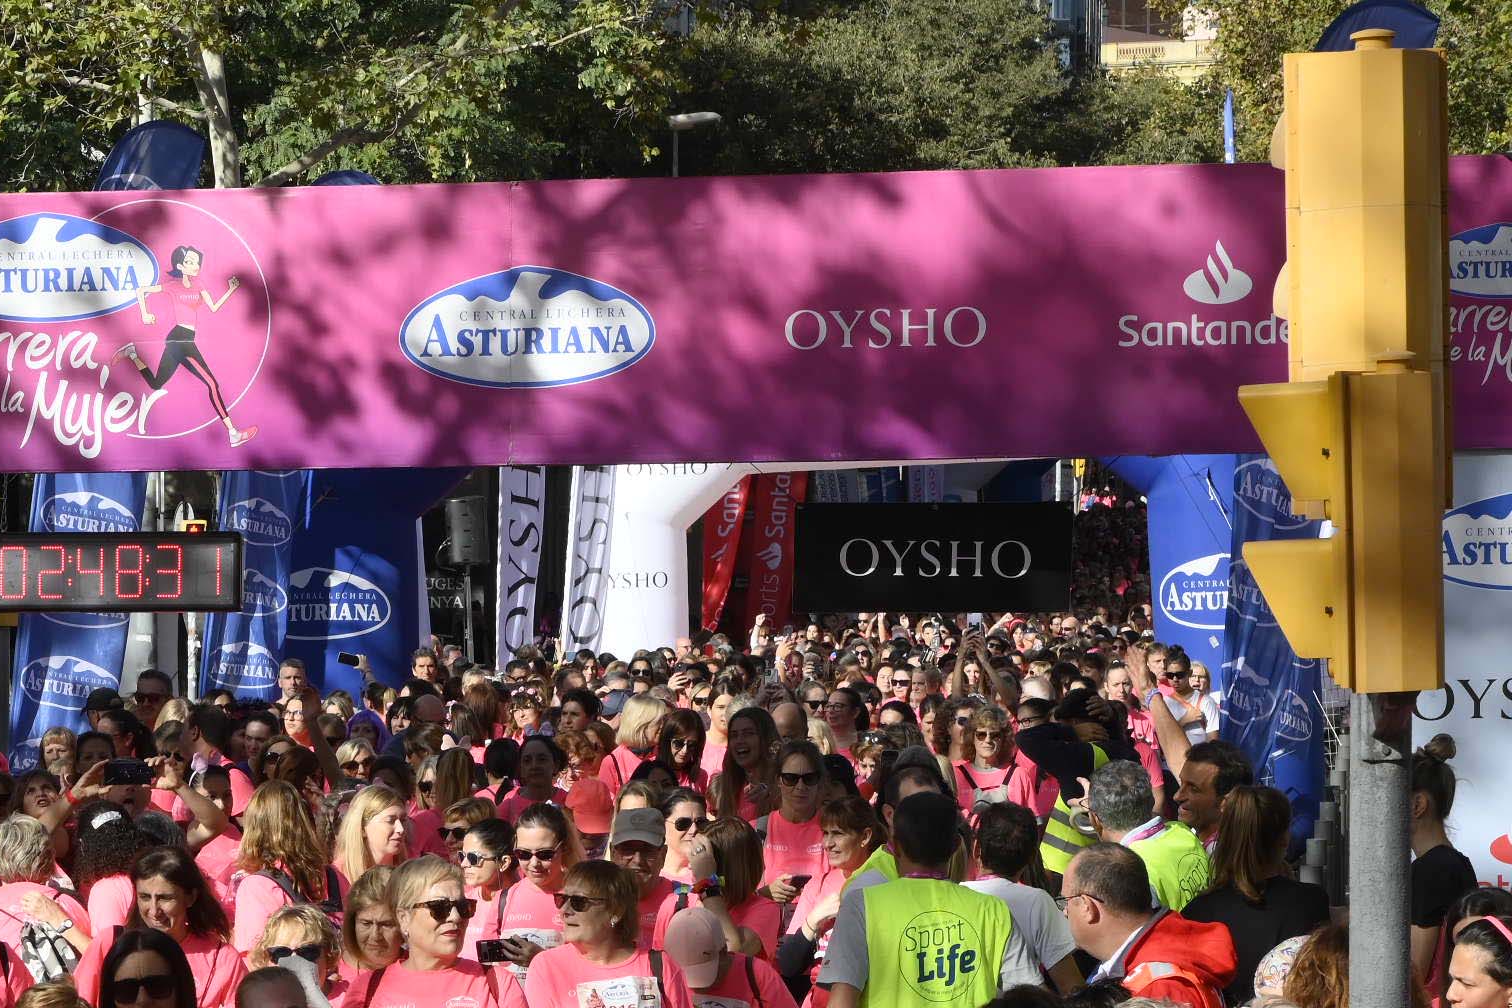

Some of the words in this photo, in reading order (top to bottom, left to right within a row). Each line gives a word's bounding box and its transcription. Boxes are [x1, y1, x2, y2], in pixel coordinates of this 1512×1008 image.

[62, 248, 135, 260] LECHERA
[459, 309, 538, 321] CENTRAL
[545, 307, 626, 319] LECHERA
[784, 306, 987, 351] OYSHO
[419, 313, 636, 358] ASTURIANA
[0, 374, 25, 414] la
[19, 364, 169, 459] Mujer
[838, 538, 1033, 579] OYSHO
[905, 919, 965, 953] Sport
[916, 943, 977, 987] Life
